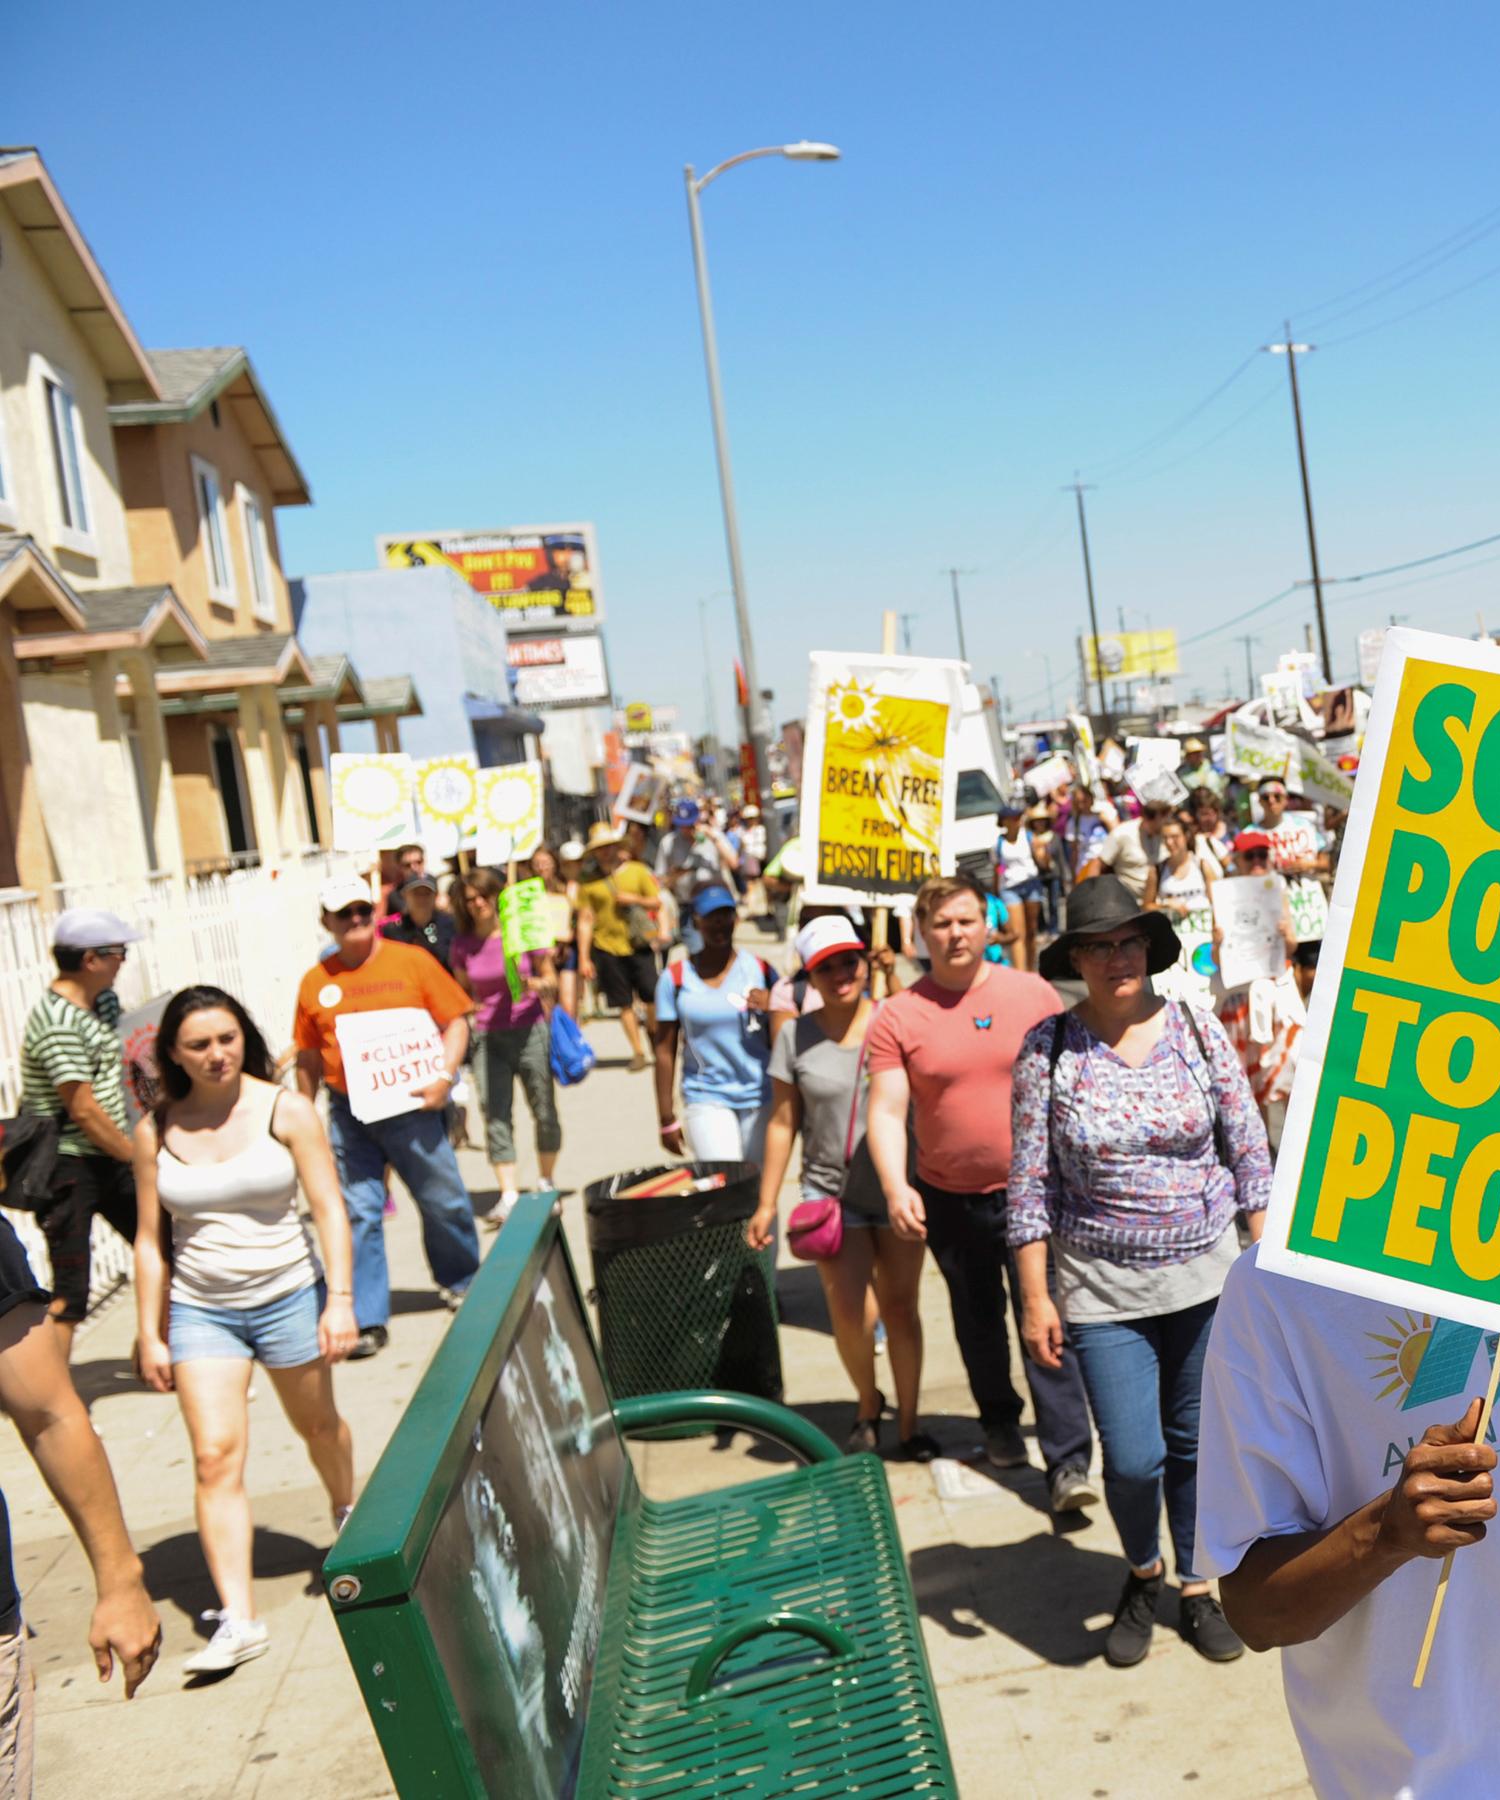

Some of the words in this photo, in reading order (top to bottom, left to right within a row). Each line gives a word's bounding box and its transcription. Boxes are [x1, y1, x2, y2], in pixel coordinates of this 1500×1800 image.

[827, 766, 885, 800] BREAK
[901, 775, 939, 806] FREE
[861, 818, 902, 839] FROM
[820, 841, 883, 877] FOSSIL
[887, 848, 941, 882] FUELS
